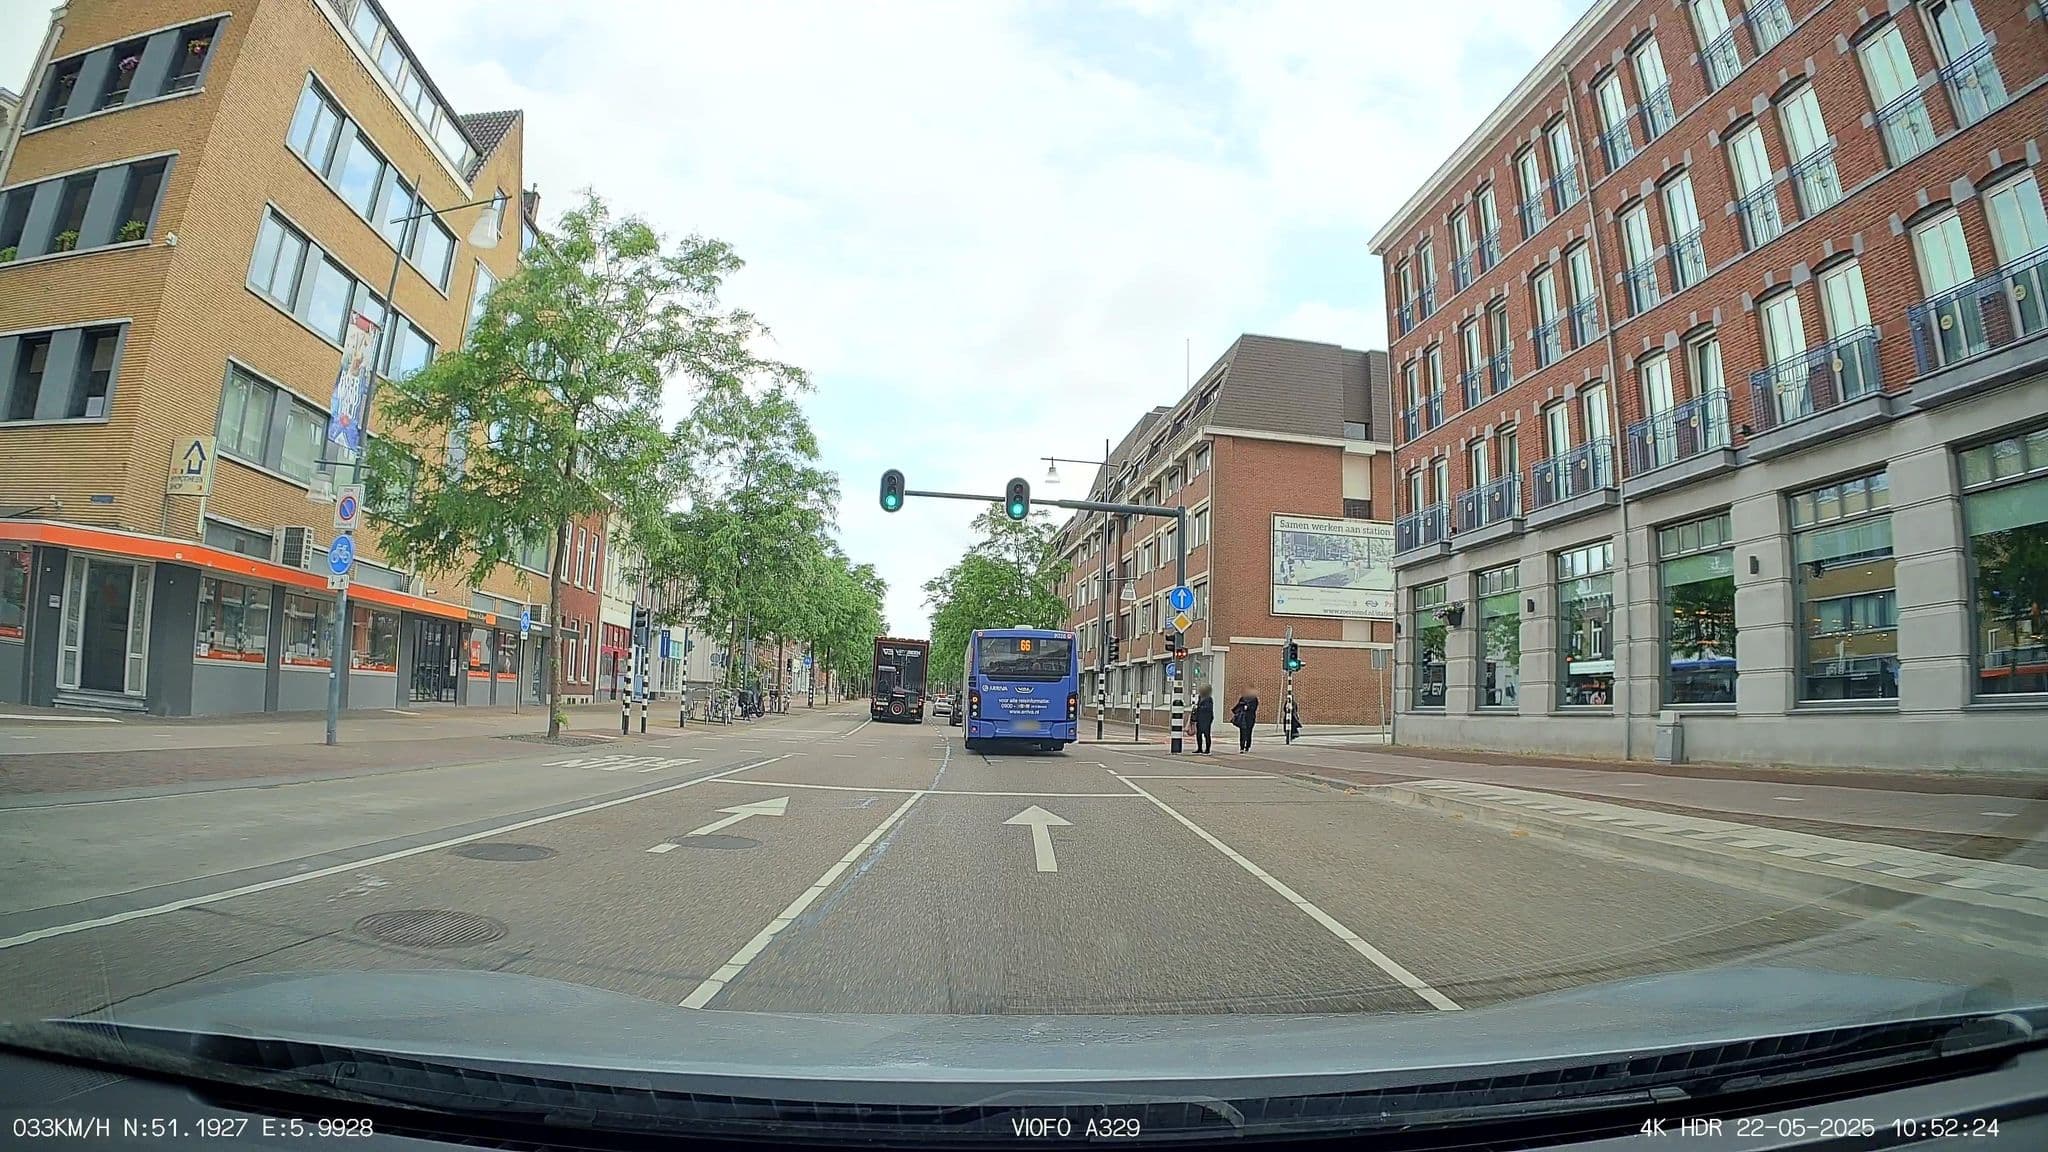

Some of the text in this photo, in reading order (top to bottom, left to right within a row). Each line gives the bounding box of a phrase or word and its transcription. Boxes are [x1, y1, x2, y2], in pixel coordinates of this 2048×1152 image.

[1280, 520, 1309, 530] Samen
[1312, 522, 1344, 532] werken
[1362, 528, 1391, 536] station
[1020, 640, 1031, 652] 66
